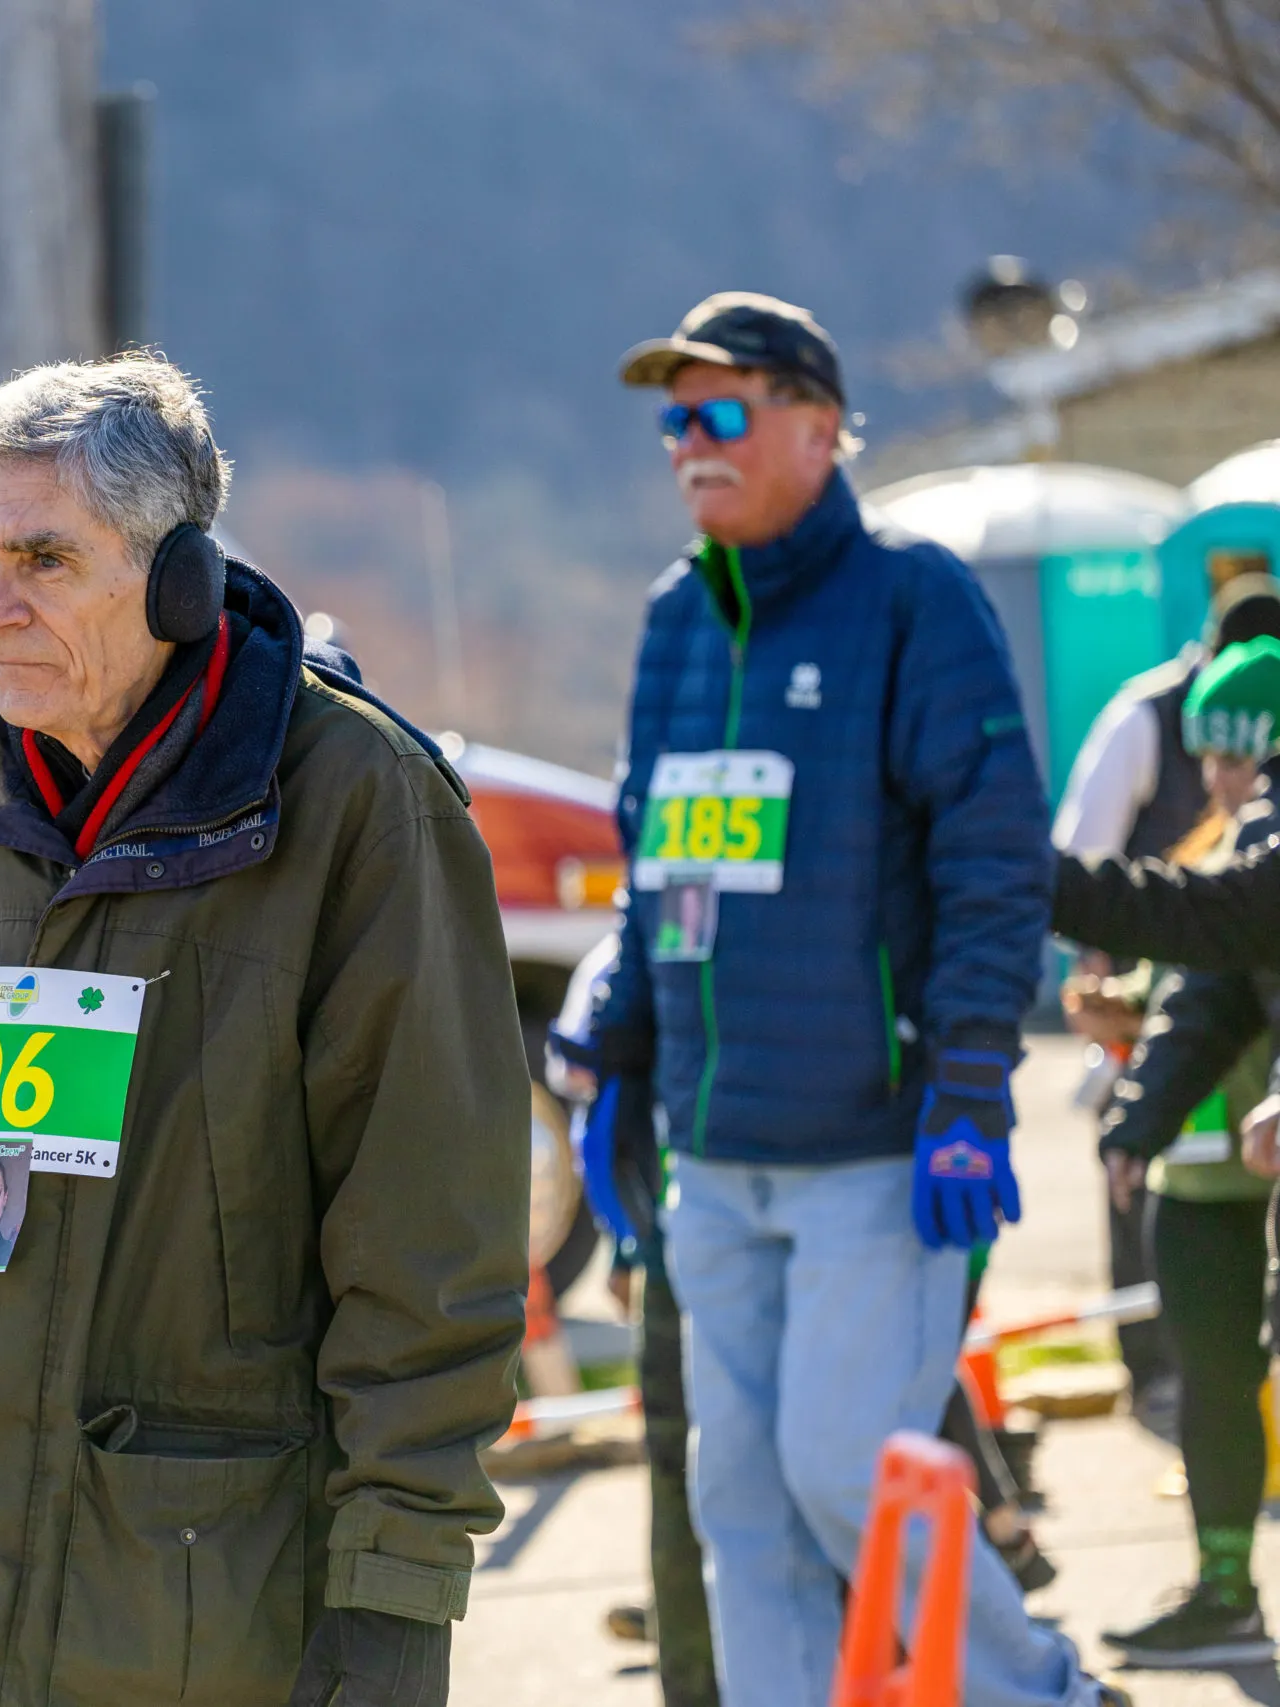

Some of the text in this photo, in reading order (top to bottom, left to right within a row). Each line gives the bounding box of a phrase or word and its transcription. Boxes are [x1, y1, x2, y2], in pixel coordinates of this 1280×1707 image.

[657, 795, 762, 862] 185
[30, 1146, 73, 1163] ancer
[75, 1149, 97, 1165] 5K
